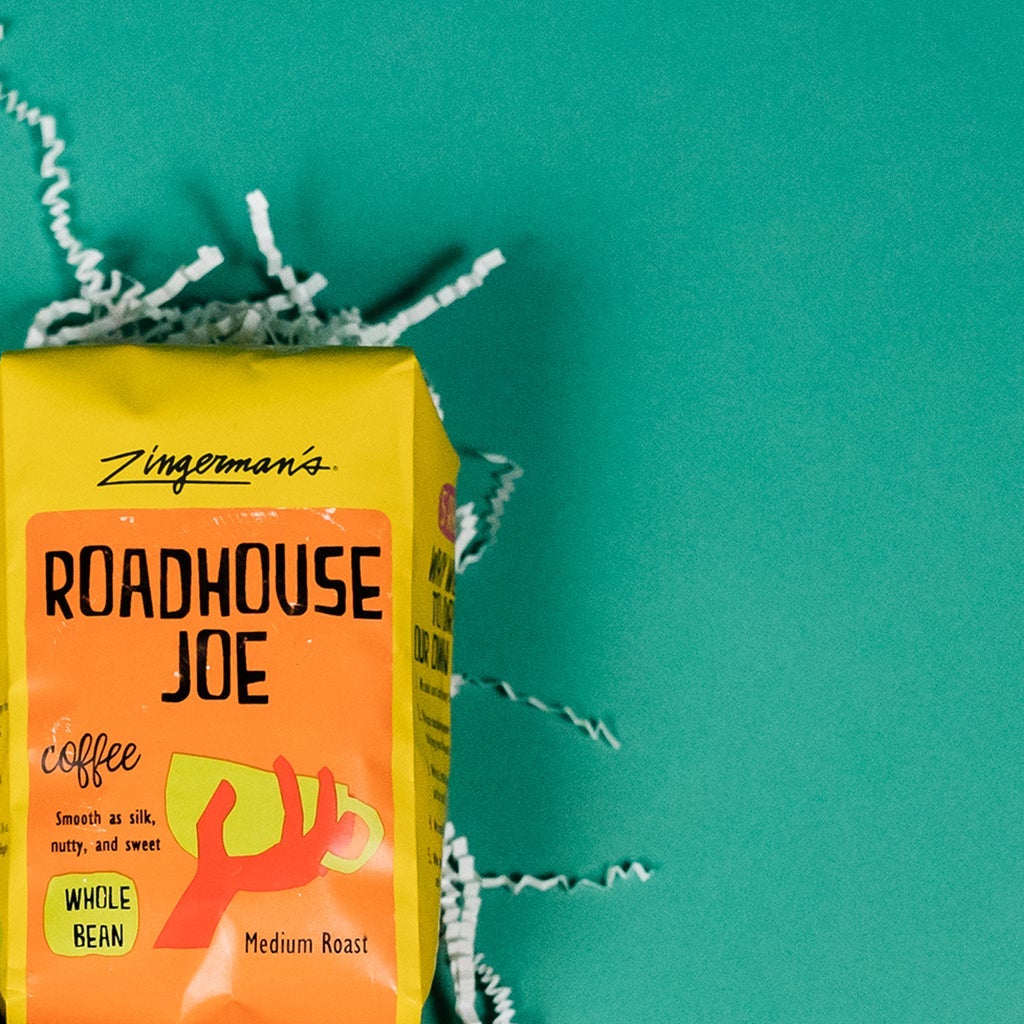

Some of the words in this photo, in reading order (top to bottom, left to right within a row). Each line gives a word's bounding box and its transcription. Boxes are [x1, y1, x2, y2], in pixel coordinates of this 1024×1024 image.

[97, 445, 331, 494] Zingerman's
[45, 543, 383, 620] ROADHOUSE
[161, 629, 269, 704] JOE
[41, 733, 141, 789] coffee
[56, 809, 102, 826] Smooth
[109, 814, 122, 825] as
[129, 809, 156, 826] silk,
[51, 839, 88, 857] nutty,
[96, 837, 118, 852] and
[126, 838, 161, 852] sweet
[65, 885, 131, 911] WHOLE
[73, 924, 124, 948] BEAN
[245, 931, 313, 954] Medium
[322, 931, 368, 954] Roast
